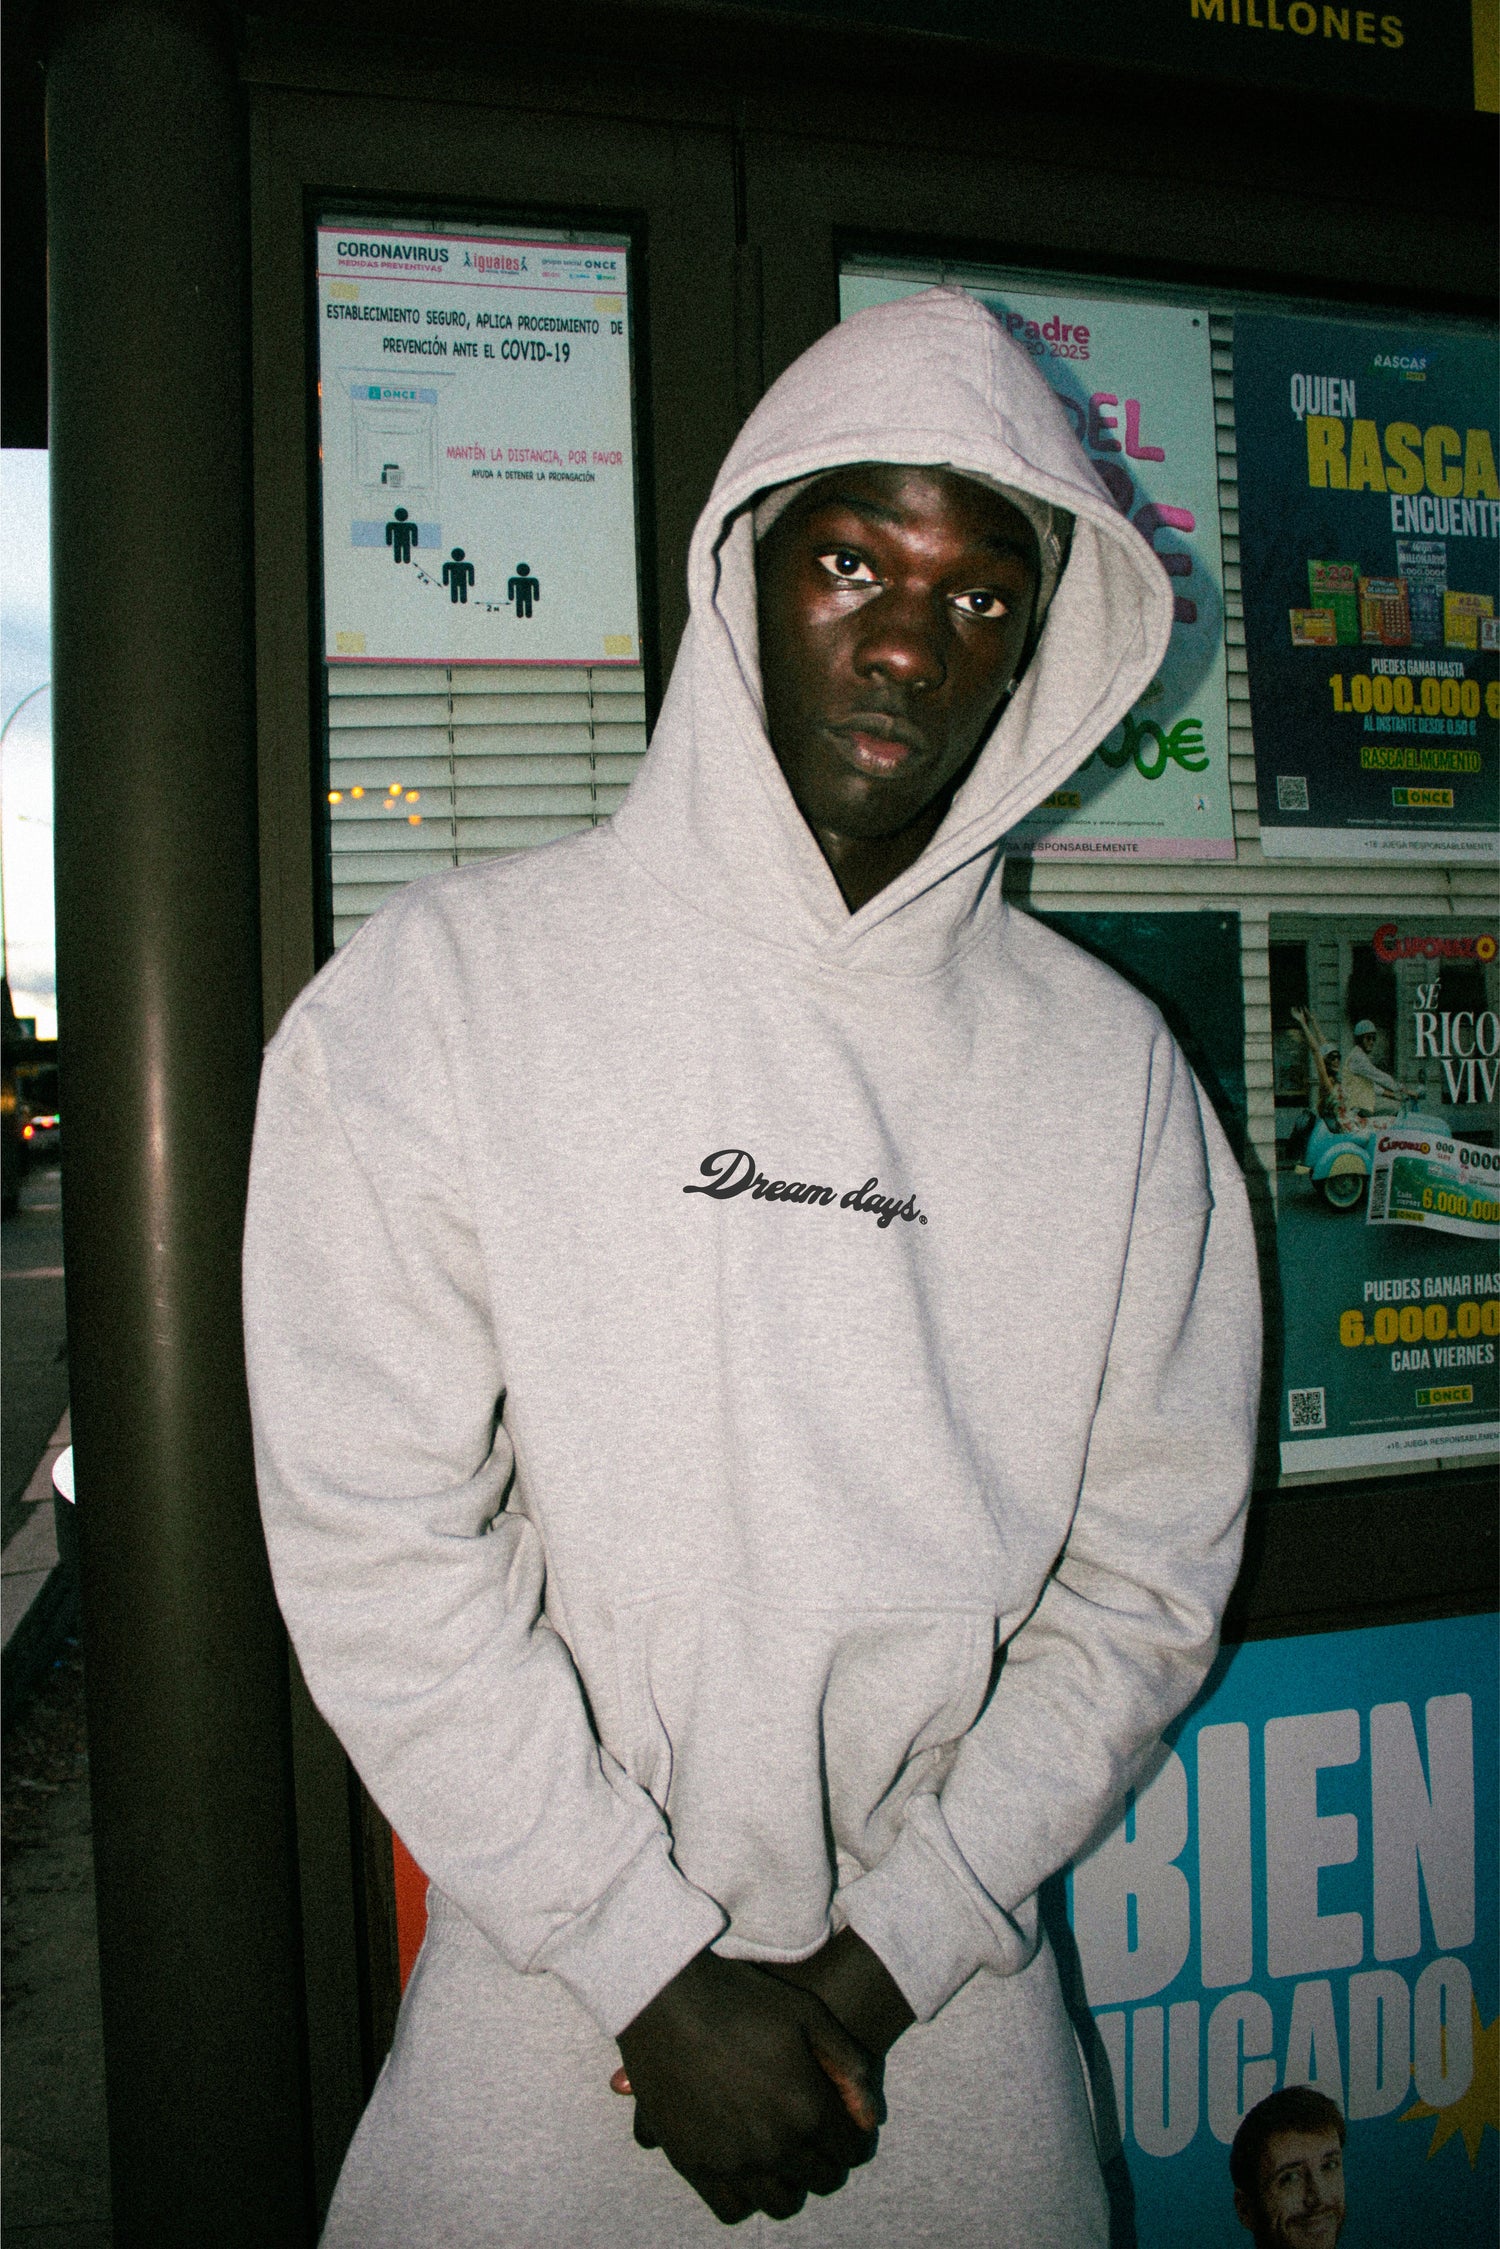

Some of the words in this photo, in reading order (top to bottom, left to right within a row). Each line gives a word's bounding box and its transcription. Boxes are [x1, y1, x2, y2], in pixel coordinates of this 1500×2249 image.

[1190, 0, 1405, 48] MILLONES
[337, 241, 449, 263] CORONAVIRUS
[473, 253, 520, 273] iguales
[338, 258, 378, 269] MEDIDAS
[380, 260, 443, 272] PREVENTIVAS
[584, 260, 617, 270] ONCE
[326, 304, 420, 324] ESTABLECIMIENTO
[426, 310, 470, 330] SEGURO,
[476, 312, 512, 330] APLICA
[518, 315, 599, 334] PROCEDIMIENTO
[610, 321, 623, 335] DE
[1005, 312, 1091, 344] Padre
[383, 335, 447, 356] PREVENCIÓN
[453, 341, 478, 357] ANTE
[484, 344, 495, 358] EL
[501, 340, 570, 363] COVID-19
[1050, 343, 1090, 361] 2025
[383, 390, 416, 400] ONCE
[1290, 373, 1356, 421] QUIEN
[446, 442, 486, 461] MANTÉN
[490, 448, 503, 461] LA
[508, 449, 563, 467] DISTANCIA,
[568, 451, 588, 464] POR
[592, 451, 622, 465] FAVOR
[1306, 414, 1500, 499] RASCA
[472, 469, 494, 479] AYUDA
[497, 470, 503, 479] A
[505, 470, 534, 480] DETENER
[537, 472, 546, 480] LA
[549, 470, 595, 482] PROPAGACIÓN
[1371, 658, 1406, 676] PUEDES
[1408, 659, 1435, 677] GANAR
[1437, 661, 1465, 678] HASTA
[1329, 673, 1481, 718] 1.000.000
[1362, 748, 1403, 768] RASCA
[1405, 749, 1419, 769] EL
[1420, 750, 1480, 772] MOMENTO
[1411, 791, 1450, 805] ONCE
[1024, 841, 1139, 853] RESPONSABLEMENTE
[1413, 978, 1441, 1010] SÉ
[682, 1149, 838, 1206] Dream
[1364, 1278, 1421, 1302] PUEDES
[1424, 1274, 1470, 1298] GANAR
[1391, 1348, 1431, 1372] CADA
[1433, 1343, 1495, 1369] VIERNES
[1433, 1388, 1470, 1402] ONCE
[1073, 1692, 1476, 2007] BIEN
